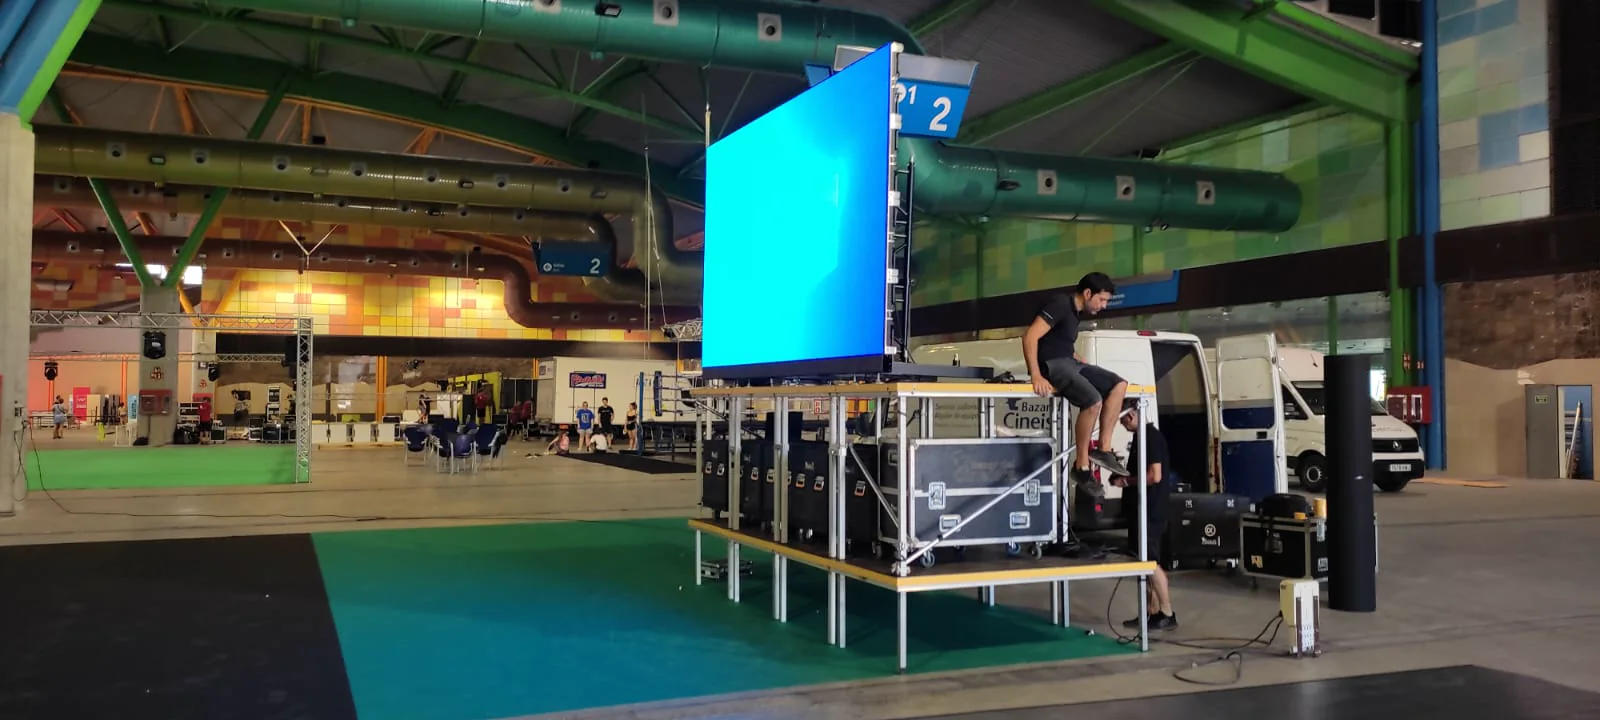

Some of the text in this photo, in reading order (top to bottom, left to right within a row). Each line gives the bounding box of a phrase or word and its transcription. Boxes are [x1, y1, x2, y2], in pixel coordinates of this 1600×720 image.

[929, 96, 952, 132] 2
[589, 257, 601, 274] 2
[1021, 401, 1051, 413] Bazar
